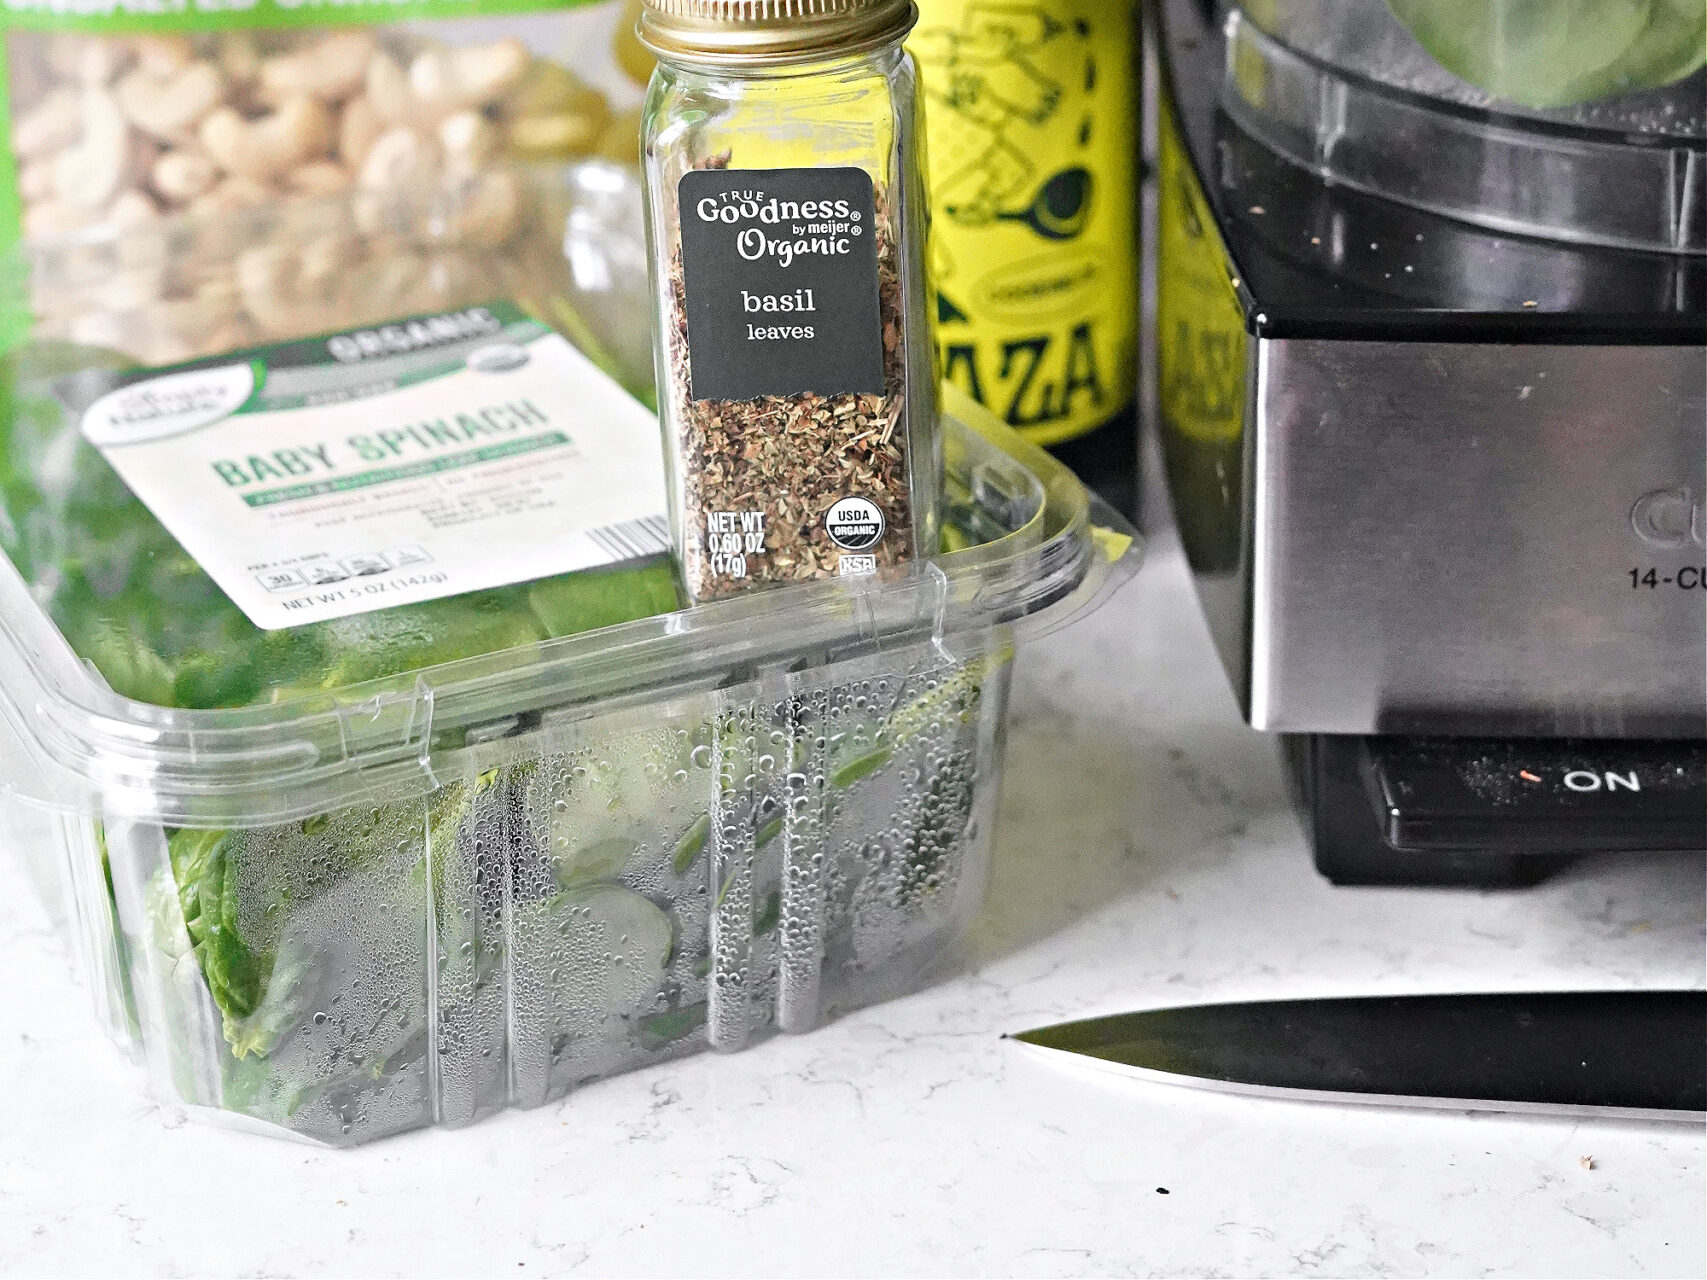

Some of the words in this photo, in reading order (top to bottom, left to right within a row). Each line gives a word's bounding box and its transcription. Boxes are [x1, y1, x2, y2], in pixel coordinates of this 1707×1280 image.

[719, 190, 765, 203] TRUE
[792, 224, 806, 236] by
[736, 228, 850, 268] Organic
[740, 289, 816, 313] basil
[746, 324, 815, 340] leaves
[210, 443, 335, 487] BABY
[347, 399, 549, 460] SPINACH
[707, 512, 737, 533] NET
[740, 511, 765, 532] WT
[838, 510, 870, 522] USDA
[834, 525, 876, 536] ORGANIC
[708, 534, 741, 554] 0.60
[745, 533, 766, 553] OZ
[710, 552, 747, 578] (17g)
[1628, 567, 1706, 589] 14-C
[282, 596, 315, 610] NET
[317, 590, 346, 604] WT
[364, 582, 386, 594] OZ
[390, 571, 449, 591] (142g)
[1563, 770, 1641, 792] ON
